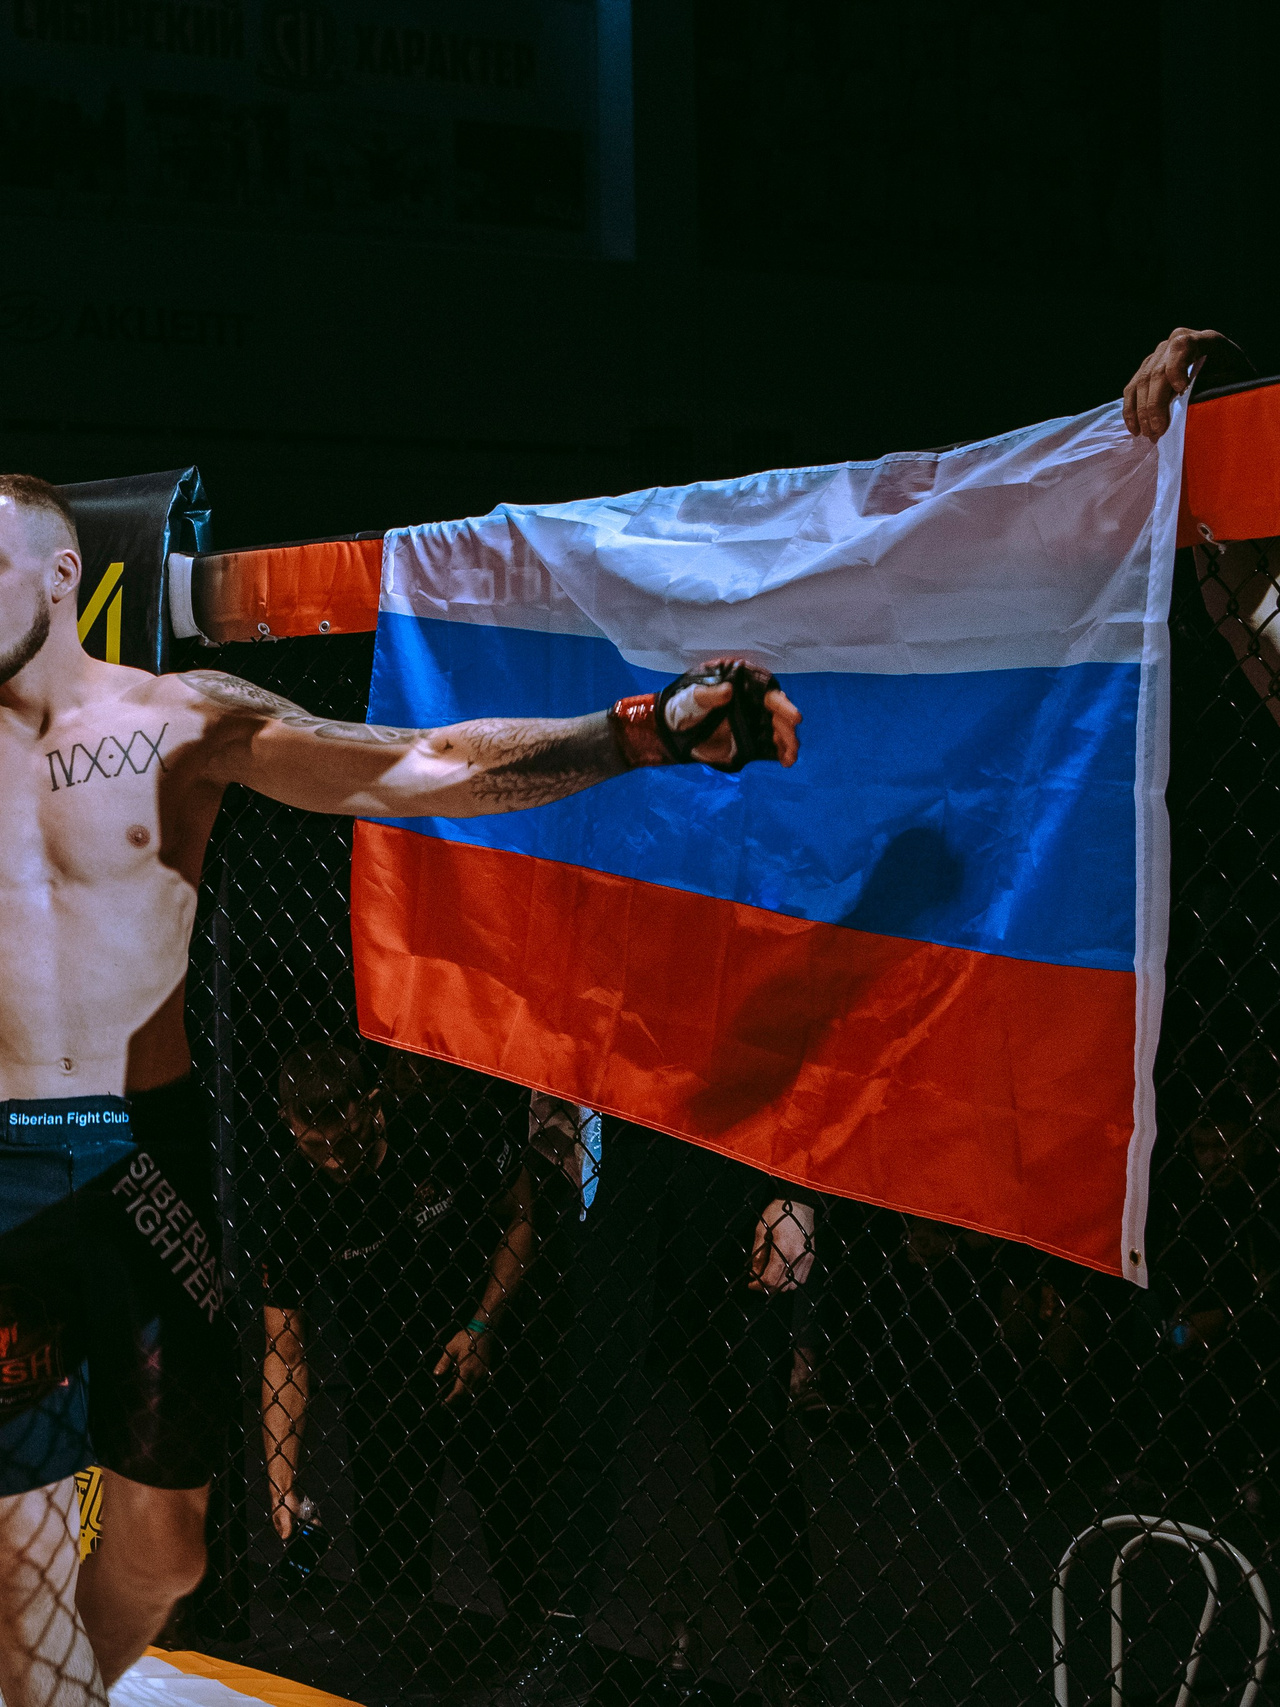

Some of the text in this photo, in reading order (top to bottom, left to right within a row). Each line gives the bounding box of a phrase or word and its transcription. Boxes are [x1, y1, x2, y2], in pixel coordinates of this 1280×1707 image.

[13, 0, 536, 89] СИБИРСКИЙ ХАРАКТЕР
[76, 303, 254, 352] АКЦЕПТ
[9, 1110, 130, 1127] Siberian Fight Club
[111, 1174, 220, 1324] FIGHTER
